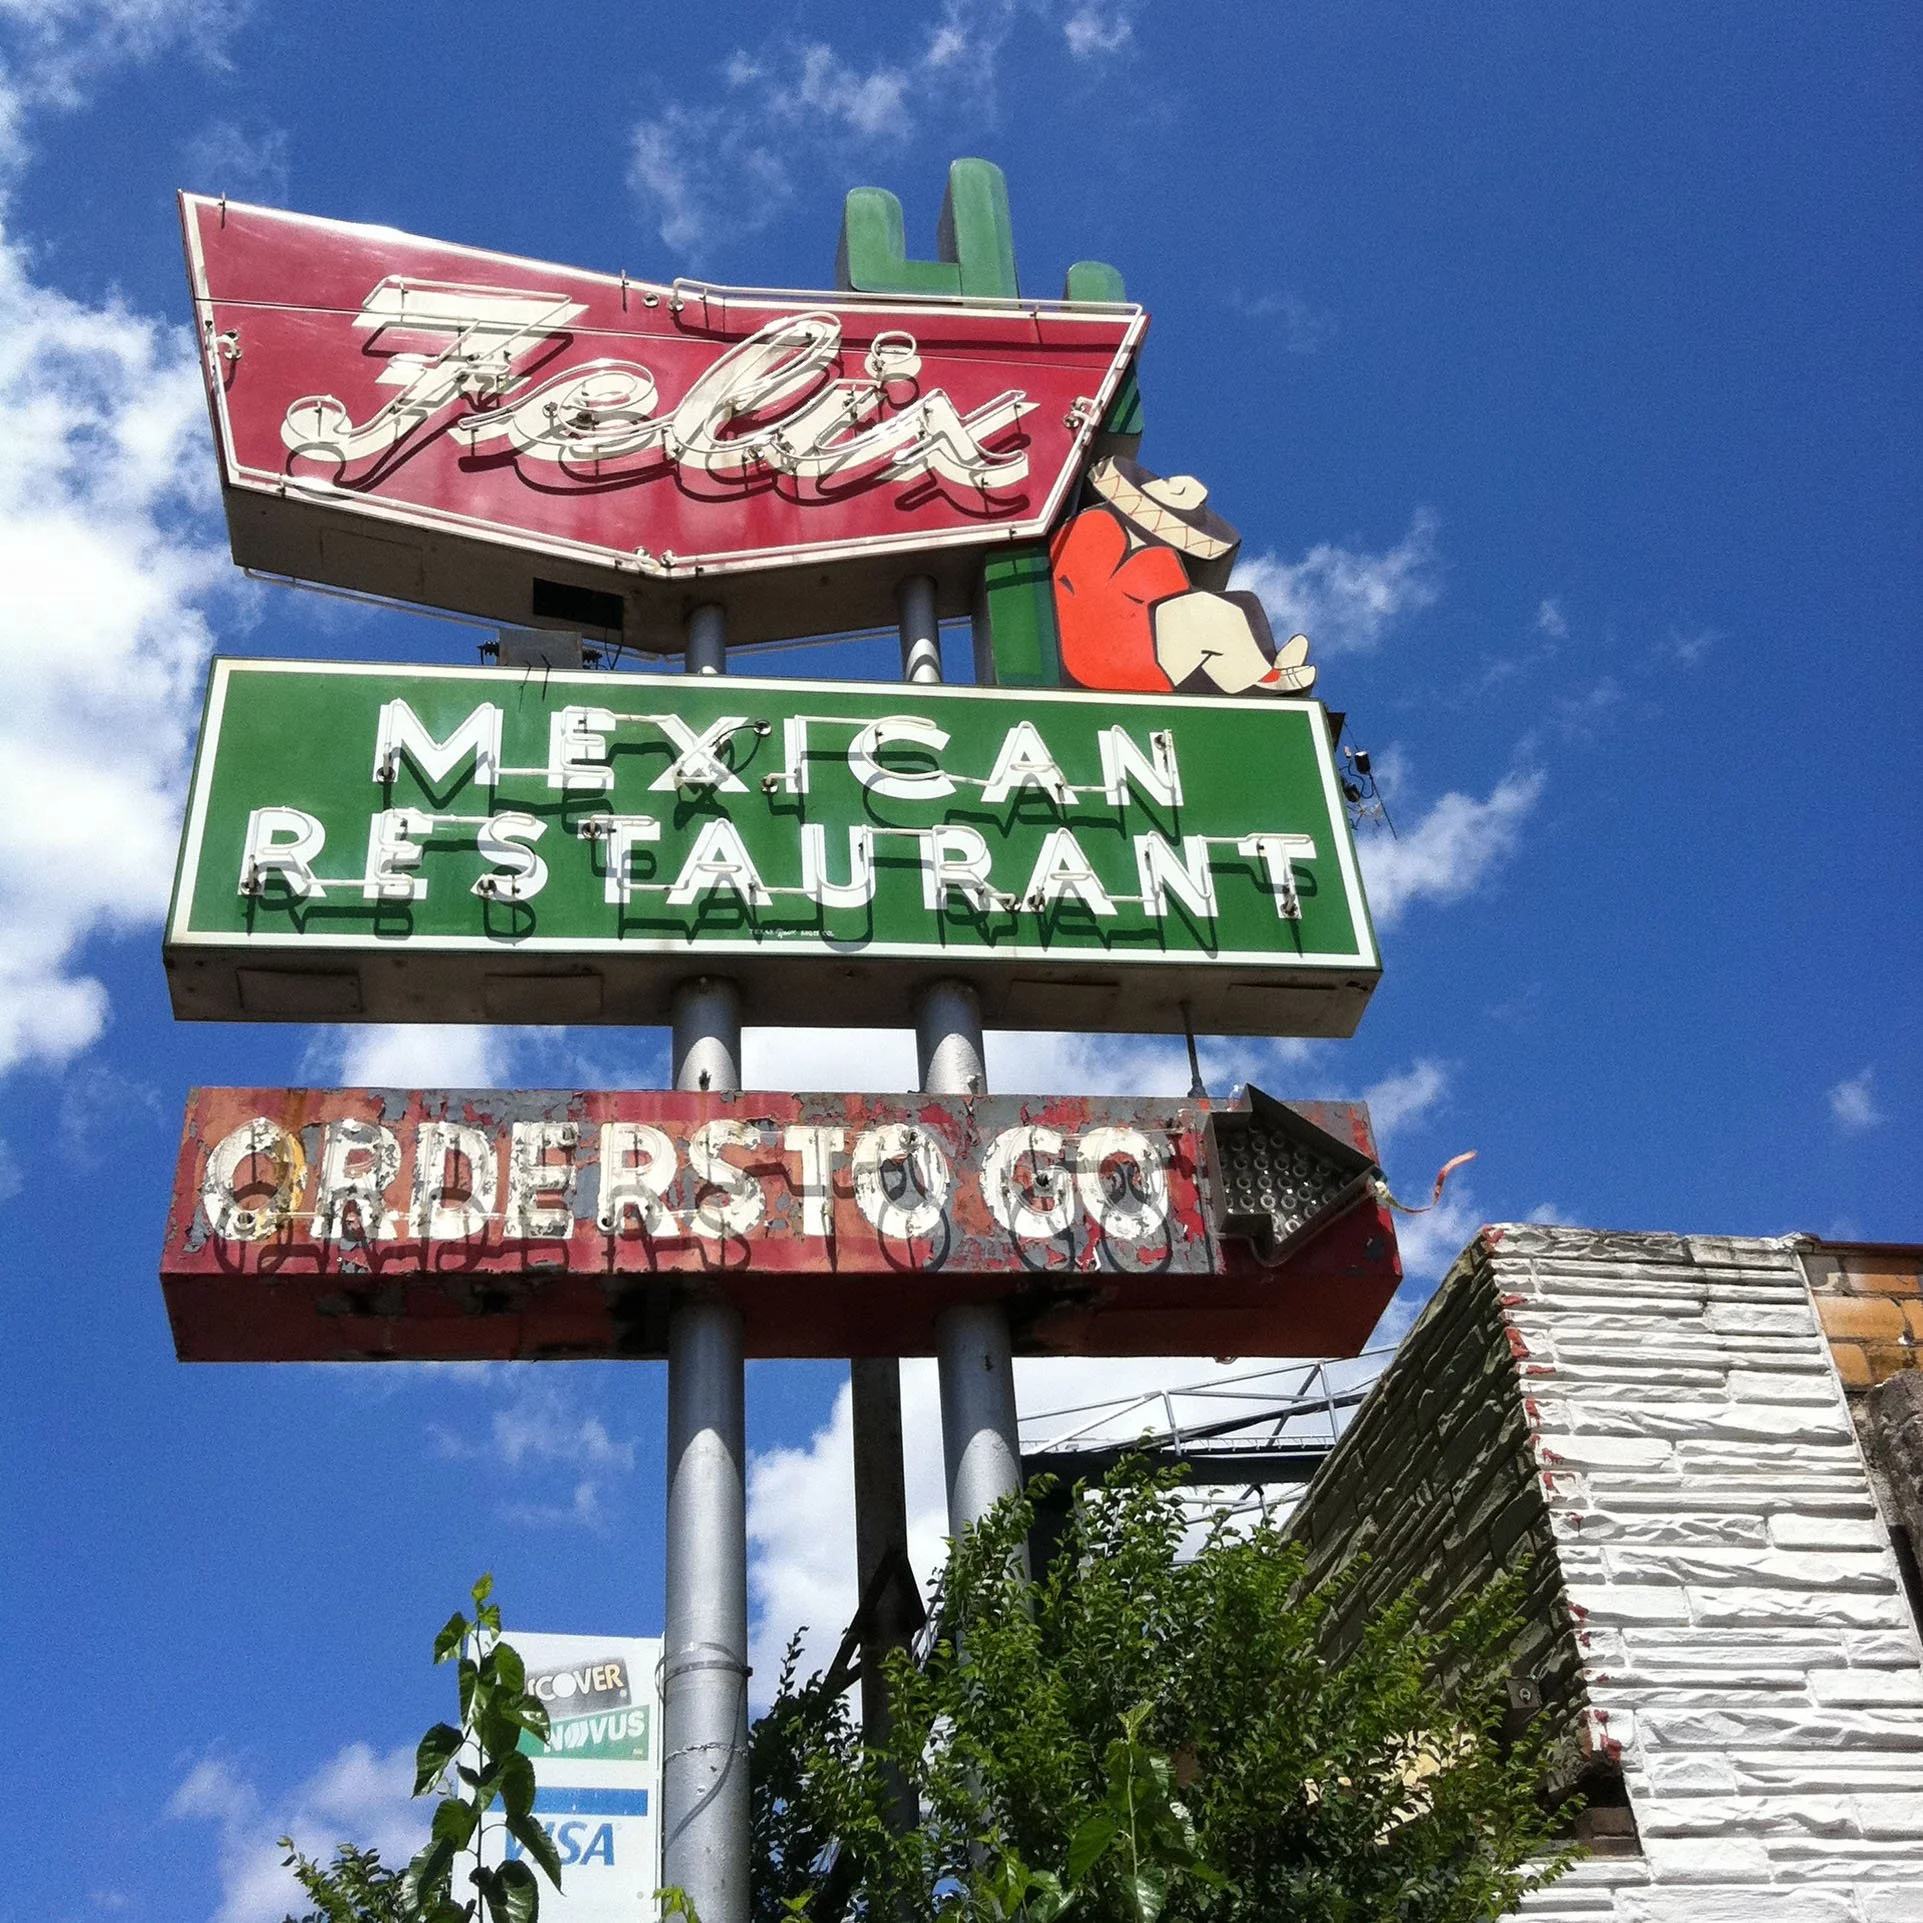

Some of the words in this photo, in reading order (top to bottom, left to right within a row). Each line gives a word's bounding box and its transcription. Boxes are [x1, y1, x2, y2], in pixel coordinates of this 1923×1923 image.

[281, 274, 1033, 487] Felix
[373, 697, 1184, 807] MEXICAN
[238, 806, 1318, 919] RESTAURANT
[202, 1117, 767, 1241] ORDERS
[783, 1122, 950, 1238] TO
[979, 1124, 1170, 1241] GO
[526, 1663, 624, 1701] COVER
[504, 1820, 615, 1866] VSA
